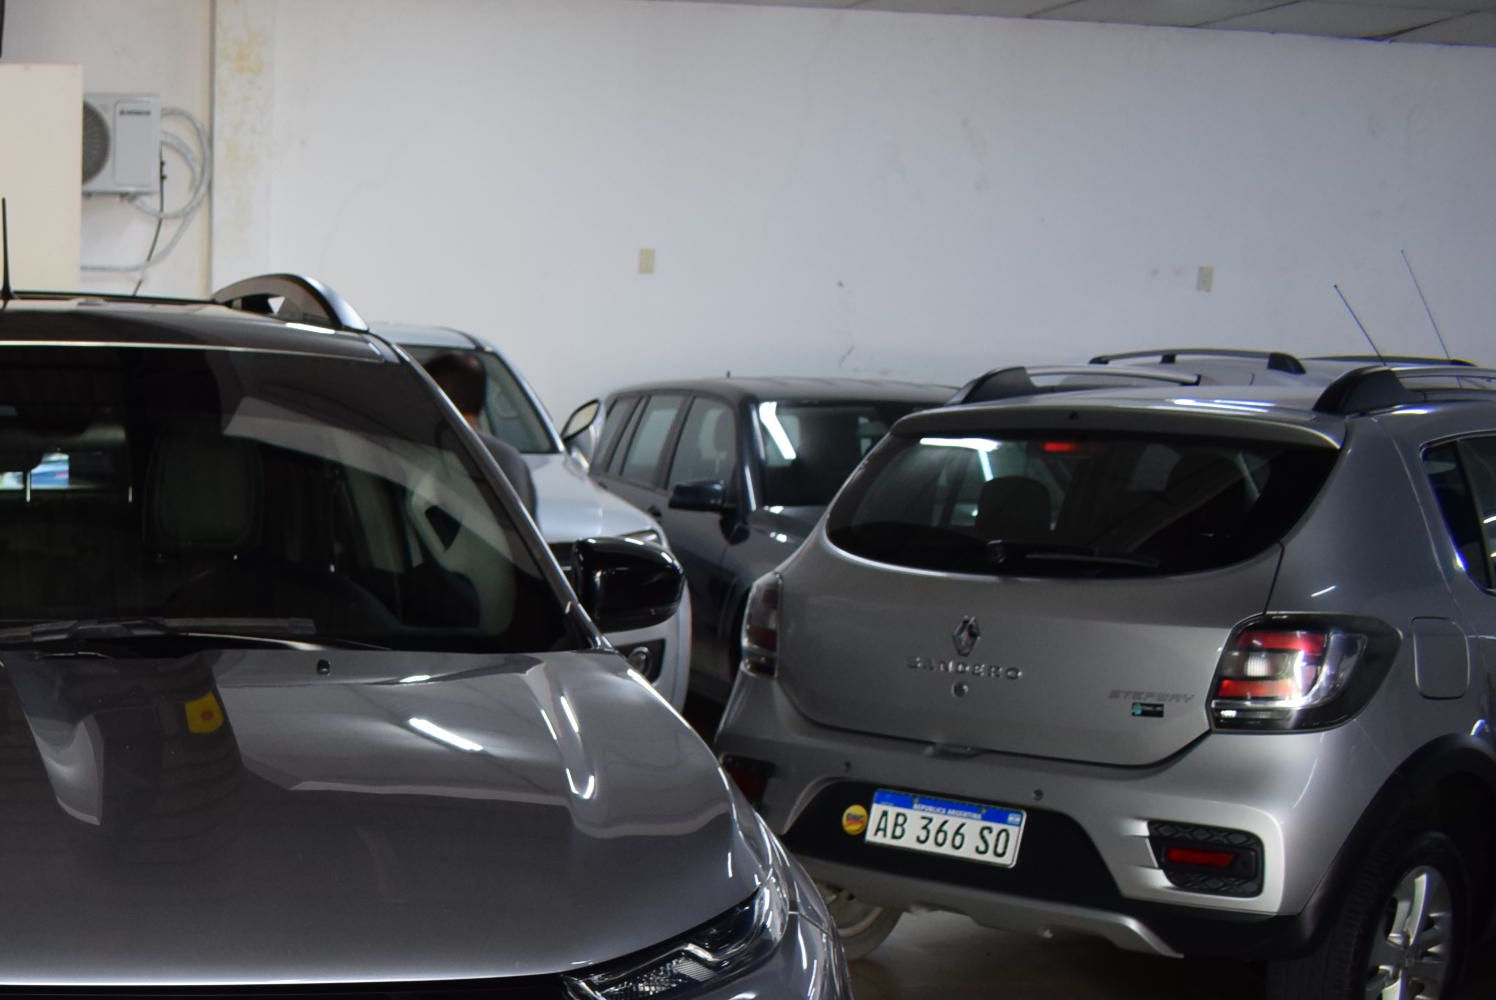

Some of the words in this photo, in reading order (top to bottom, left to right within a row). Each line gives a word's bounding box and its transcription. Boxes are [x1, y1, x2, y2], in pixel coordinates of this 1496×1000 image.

[874, 809, 908, 840] AB
[916, 816, 967, 850] 366
[975, 826, 1011, 858] SO
